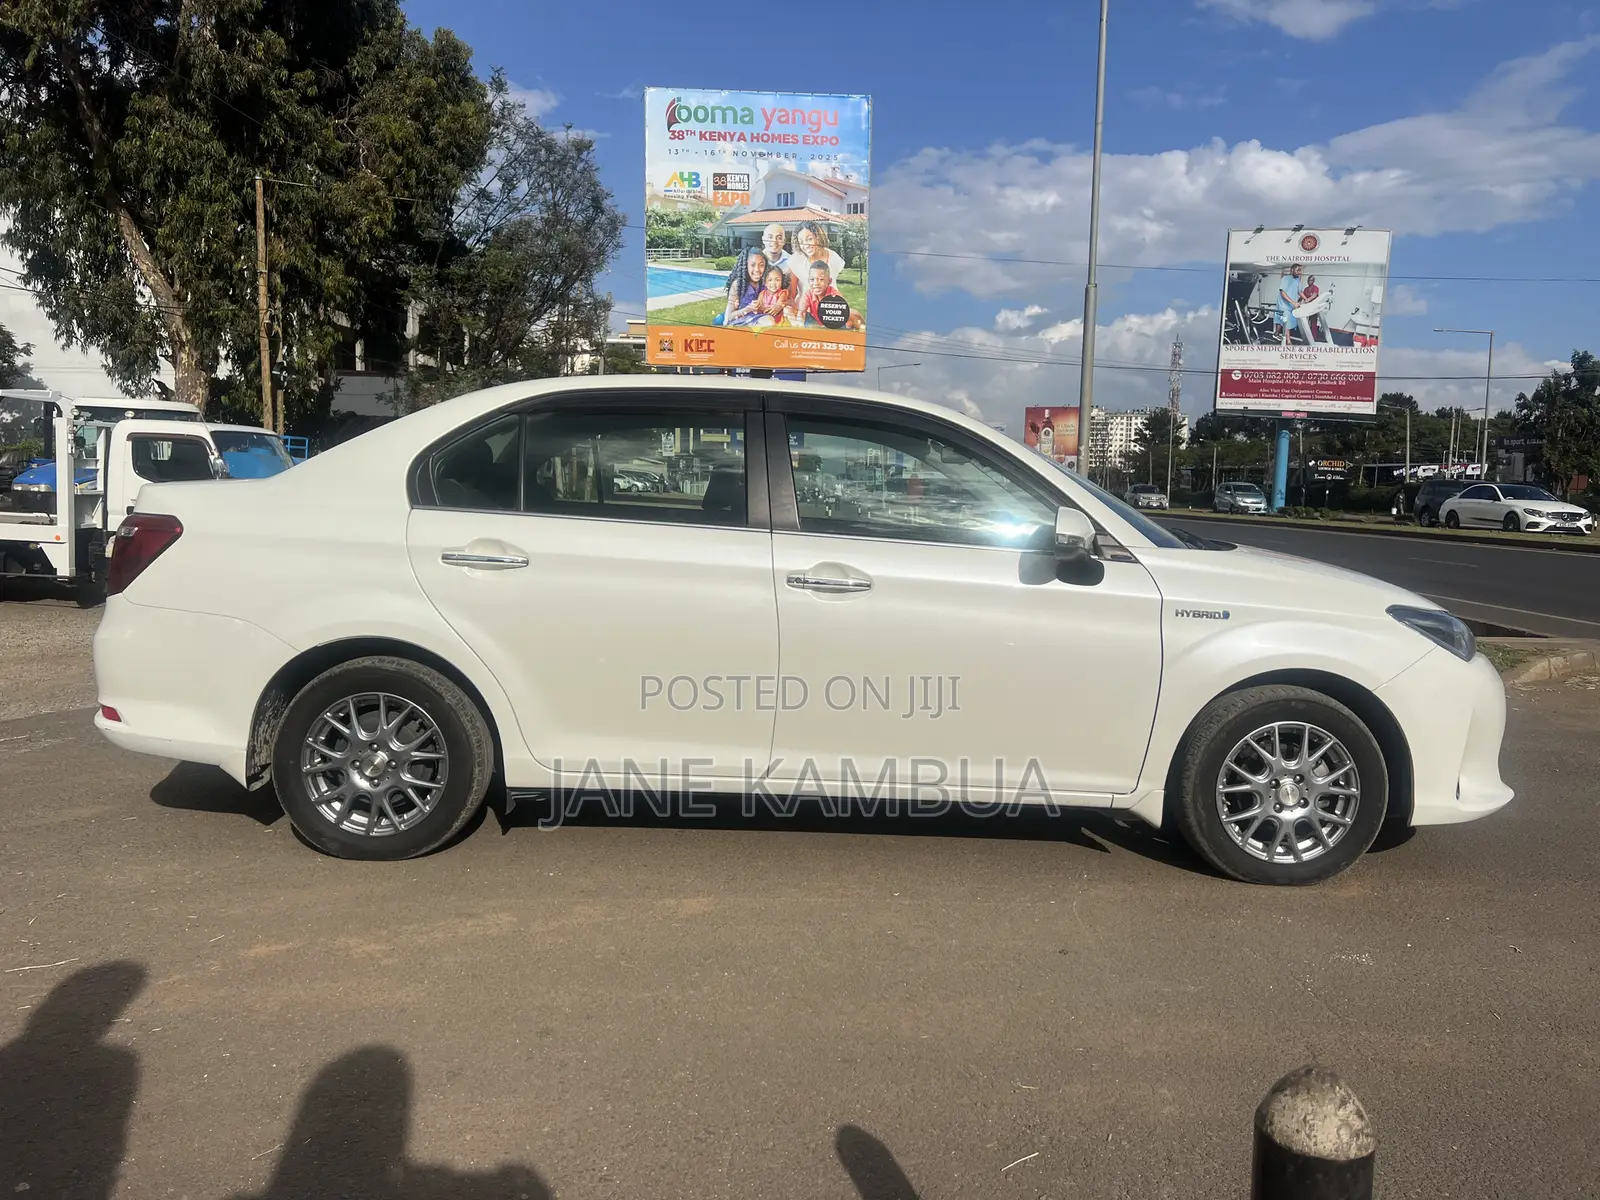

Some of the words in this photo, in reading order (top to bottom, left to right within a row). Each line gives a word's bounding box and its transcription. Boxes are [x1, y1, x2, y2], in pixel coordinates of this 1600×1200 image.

[761, 107, 839, 133] yangu
[668, 130, 696, 141] 38TH
[699, 131, 747, 142] KENYA
[750, 133, 799, 144] HOMES
[802, 134, 840, 146] EXPO
[664, 172, 702, 188] AHB
[713, 176, 727, 187] 38
[726, 174, 748, 182] KENYA
[726, 182, 748, 190] HOMES
[713, 191, 750, 206] EXPO
[774, 340, 788, 348] Call
[1175, 608, 1222, 620] HYBRID
